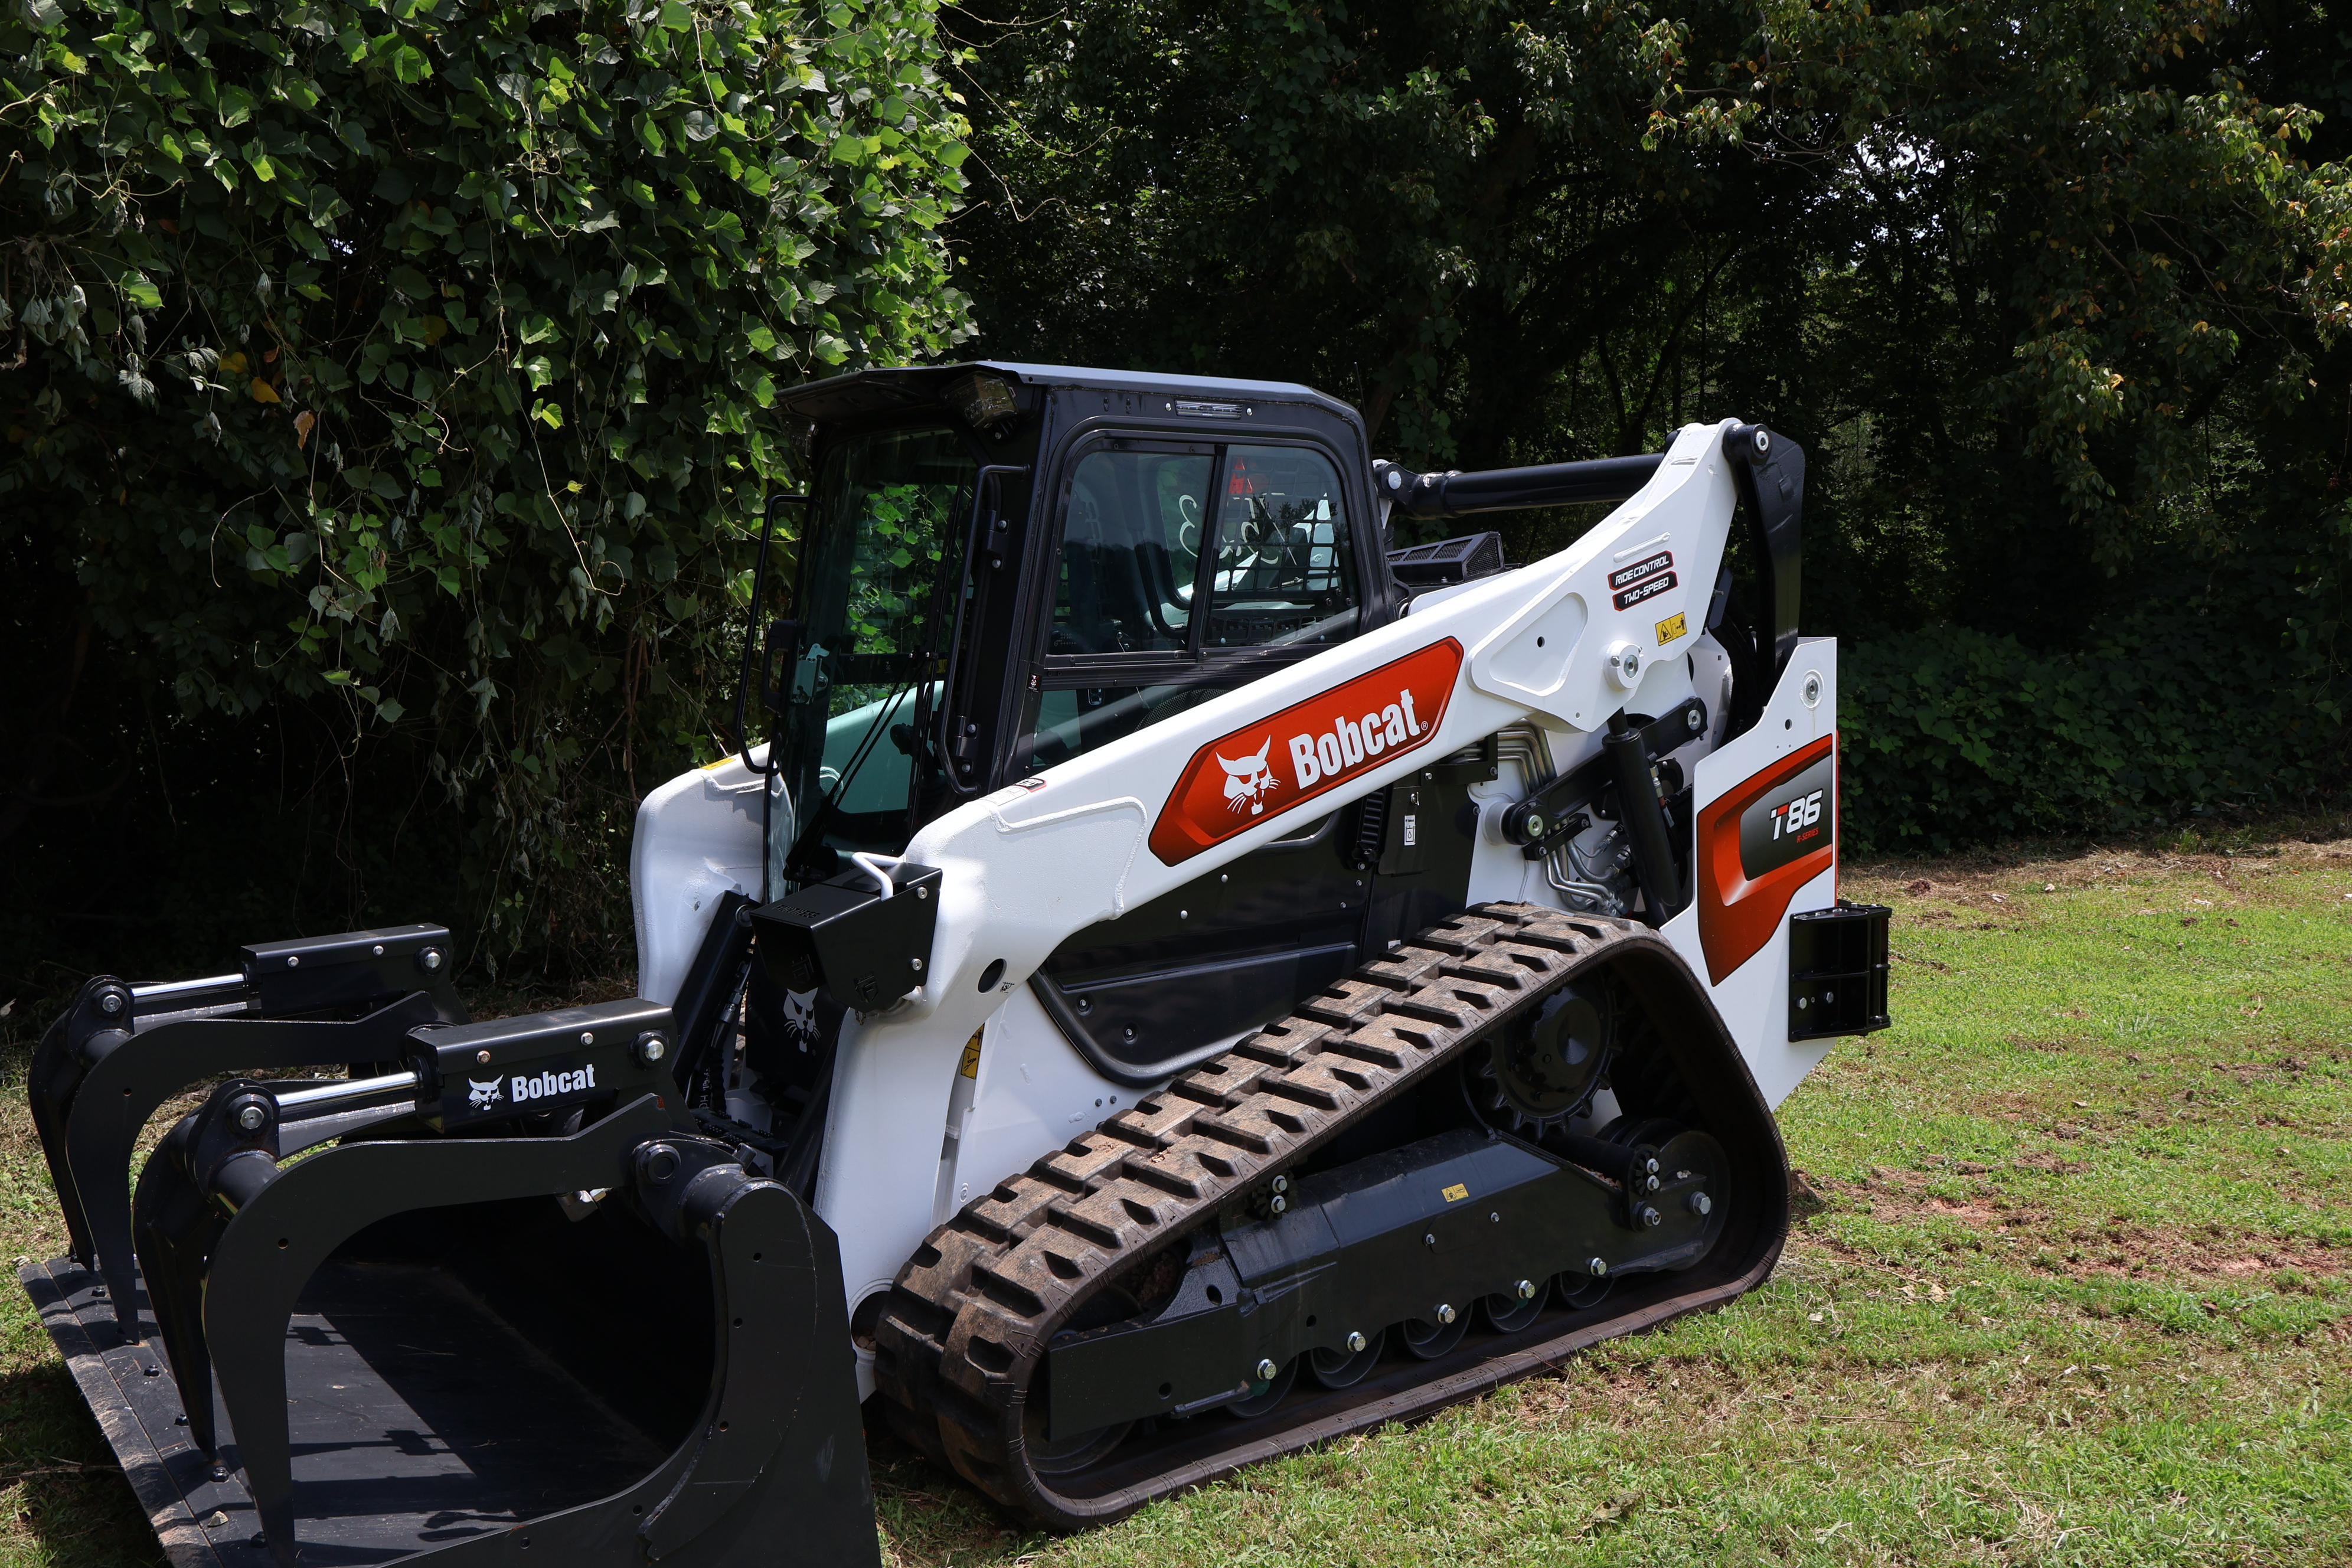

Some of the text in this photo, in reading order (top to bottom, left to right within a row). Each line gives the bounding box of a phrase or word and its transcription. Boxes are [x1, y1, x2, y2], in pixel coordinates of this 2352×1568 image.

[1623, 577, 1669, 605] TWO-SPEED
[1288, 688, 1420, 790] Bobcat
[1770, 789, 1823, 841] T86
[1796, 827, 1819, 843] R-SERIES
[511, 1064, 596, 1103] Bobcat
